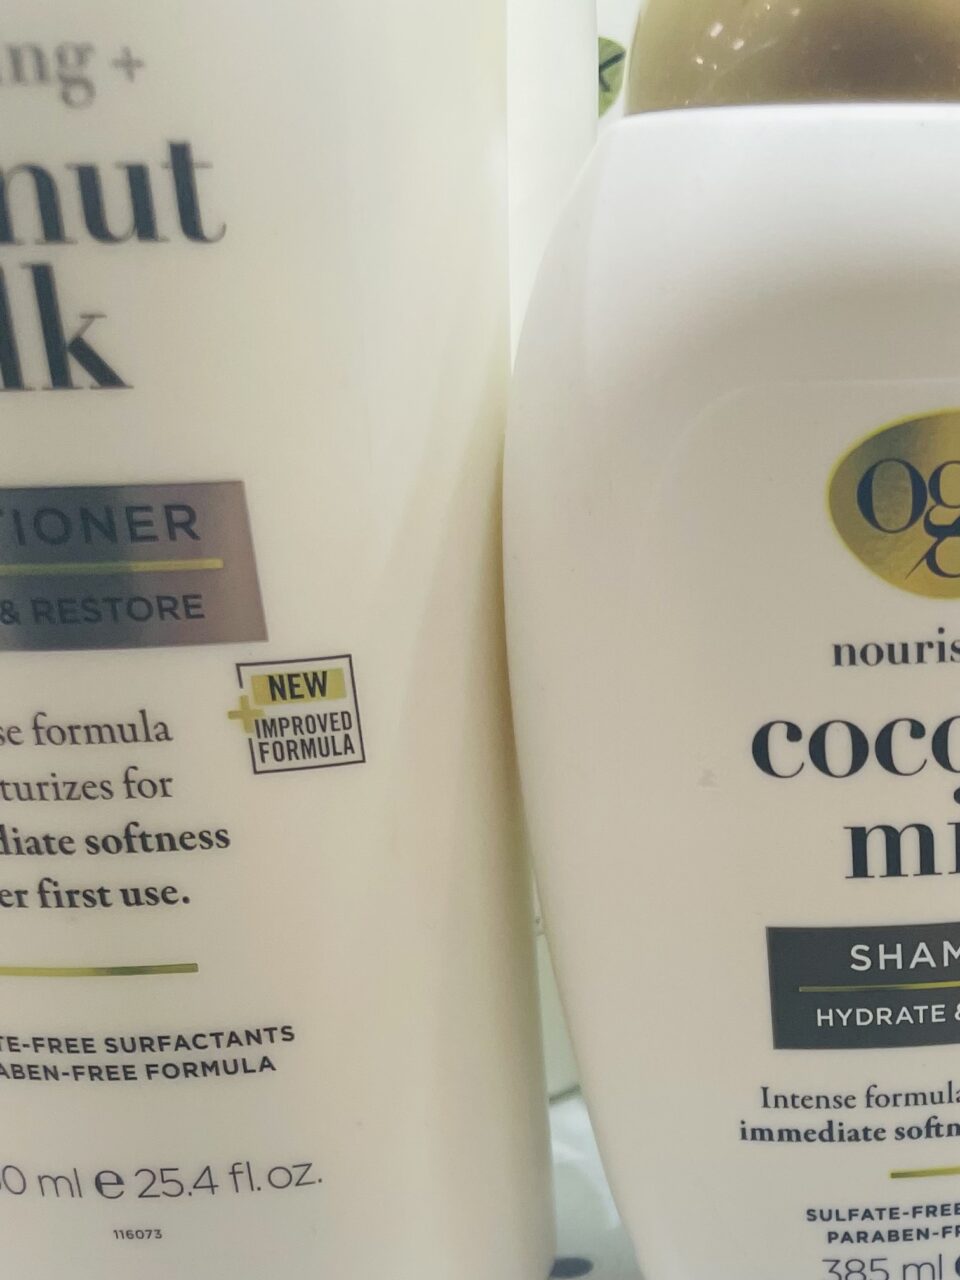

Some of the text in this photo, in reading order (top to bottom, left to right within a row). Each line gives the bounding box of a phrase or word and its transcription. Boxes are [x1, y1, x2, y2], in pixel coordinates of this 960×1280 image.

[0, 41, 95, 109] ng
[0, 139, 226, 244] nut
[0, 503, 201, 546] IONER
[30, 594, 205, 625] RESTORE
[268, 671, 328, 701] NEW
[32, 709, 174, 746] formula
[254, 710, 353, 740] IMPROVED
[258, 733, 356, 764] FORMULA
[0, 766, 173, 801] turizes for
[85, 820, 231, 856] softness
[37, 876, 113, 909] first
[119, 884, 191, 908] use.
[816, 1003, 946, 1028] HYDRATE
[104, 1025, 296, 1054] SURFACTANTS
[146, 1055, 277, 1081] FORMULA
[760, 1085, 857, 1110] Intense
[739, 1114, 887, 1143] immediate
[0, 1165, 26, 1196] 0
[38, 1167, 83, 1199] ml
[134, 1165, 219, 1199] 25.4
[113, 1229, 162, 1240] 116073
